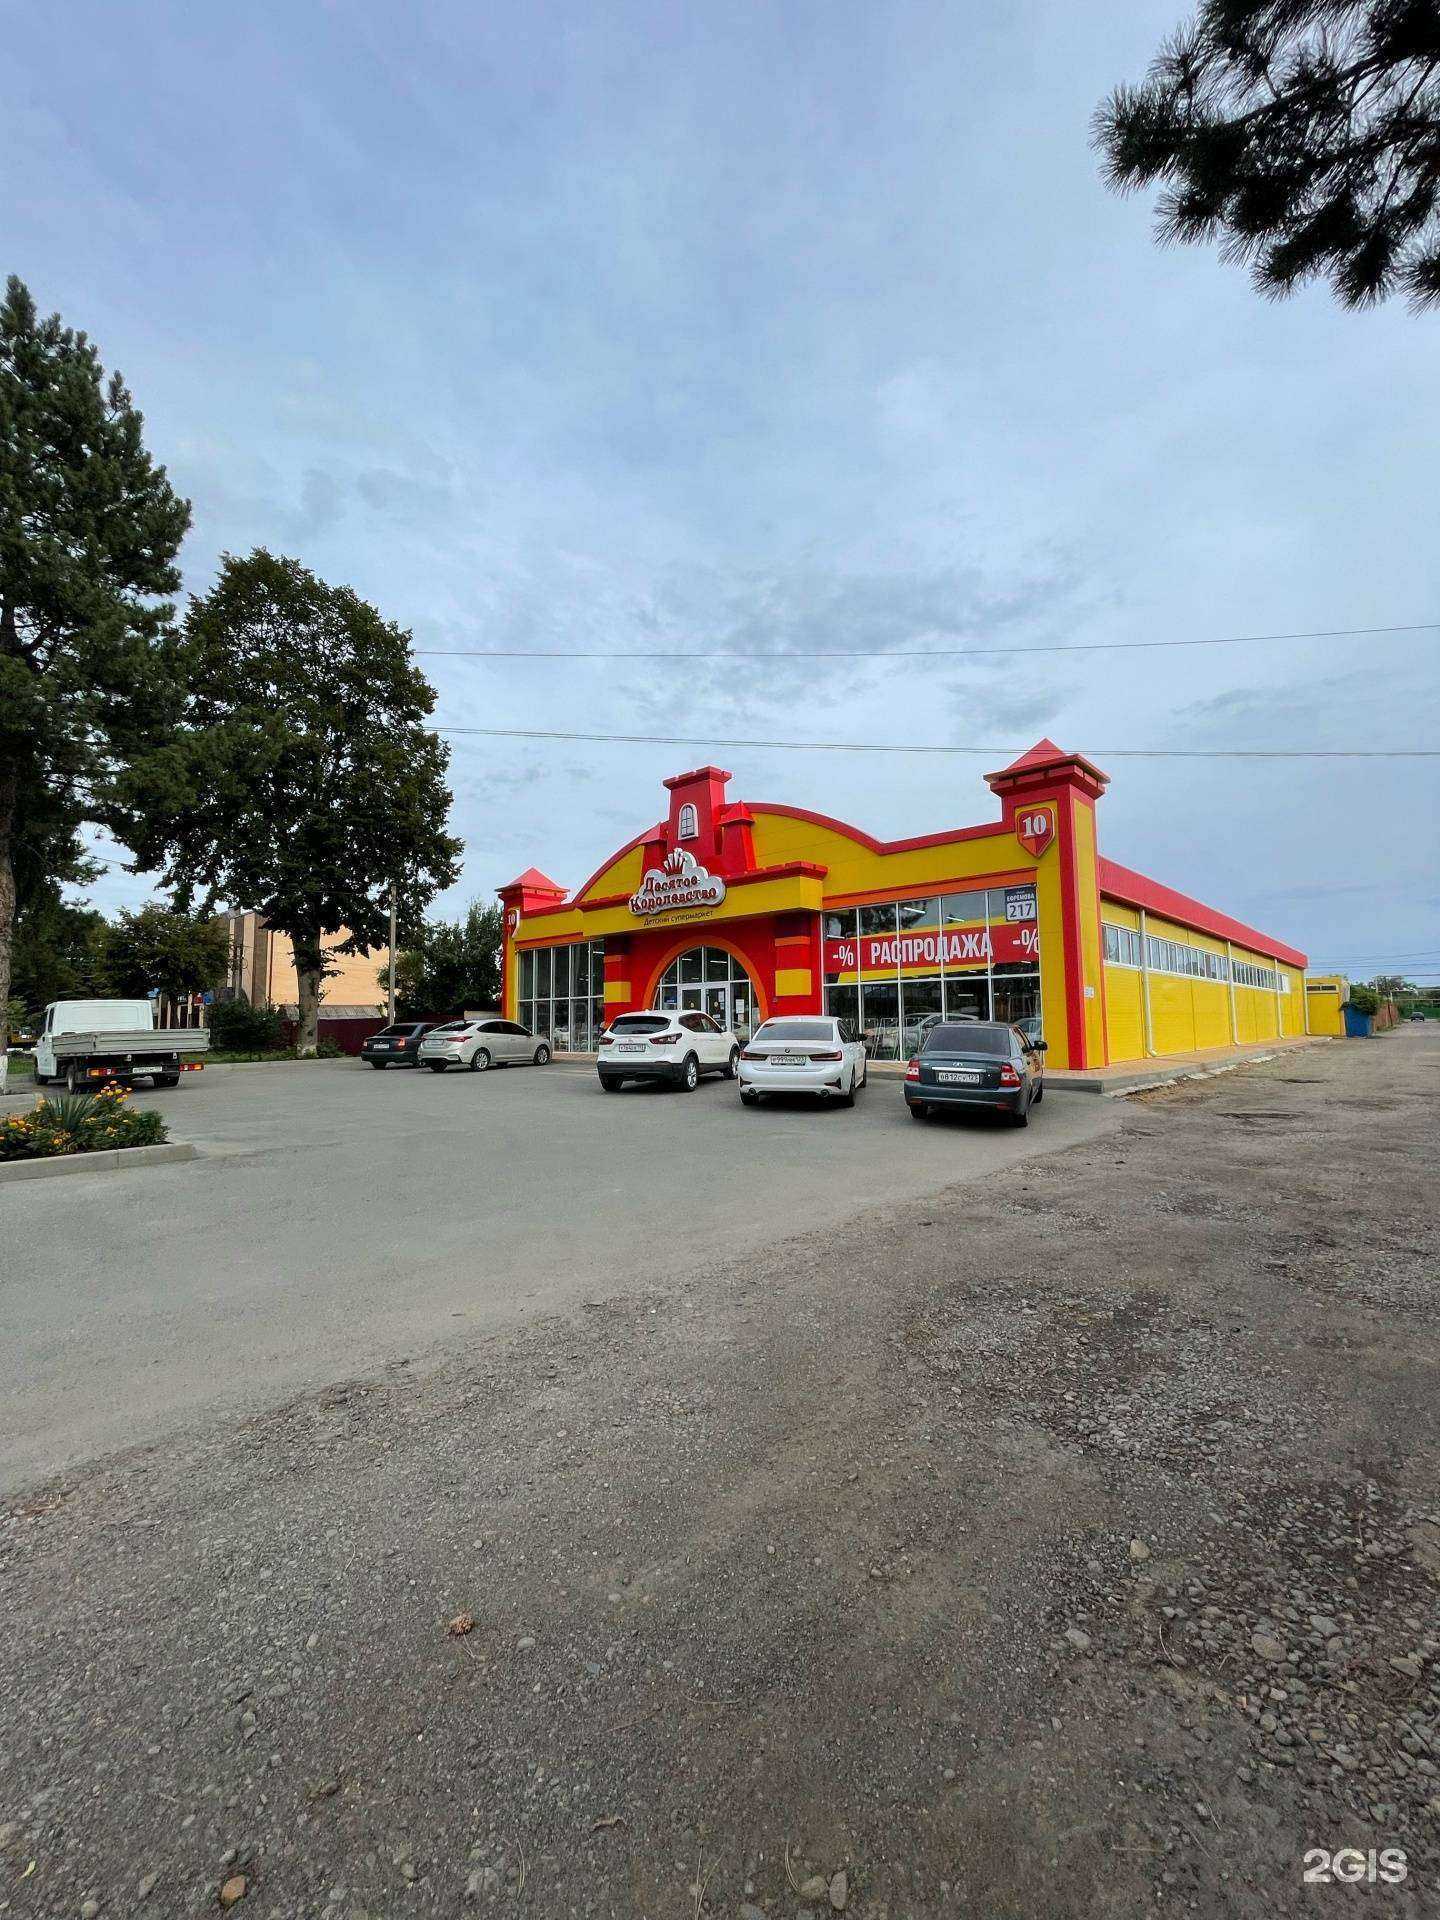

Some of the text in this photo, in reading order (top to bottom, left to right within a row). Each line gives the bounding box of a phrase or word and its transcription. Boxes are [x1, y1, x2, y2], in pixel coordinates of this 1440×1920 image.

[1022, 814, 1047, 837] 10
[643, 875, 700, 897] Десятое
[630, 888, 717, 912] Королевство
[1009, 903, 1033, 918] 217
[644, 910, 713, 926] Детский супермаркет
[871, 932, 993, 965] РАСПРОДАЖА
